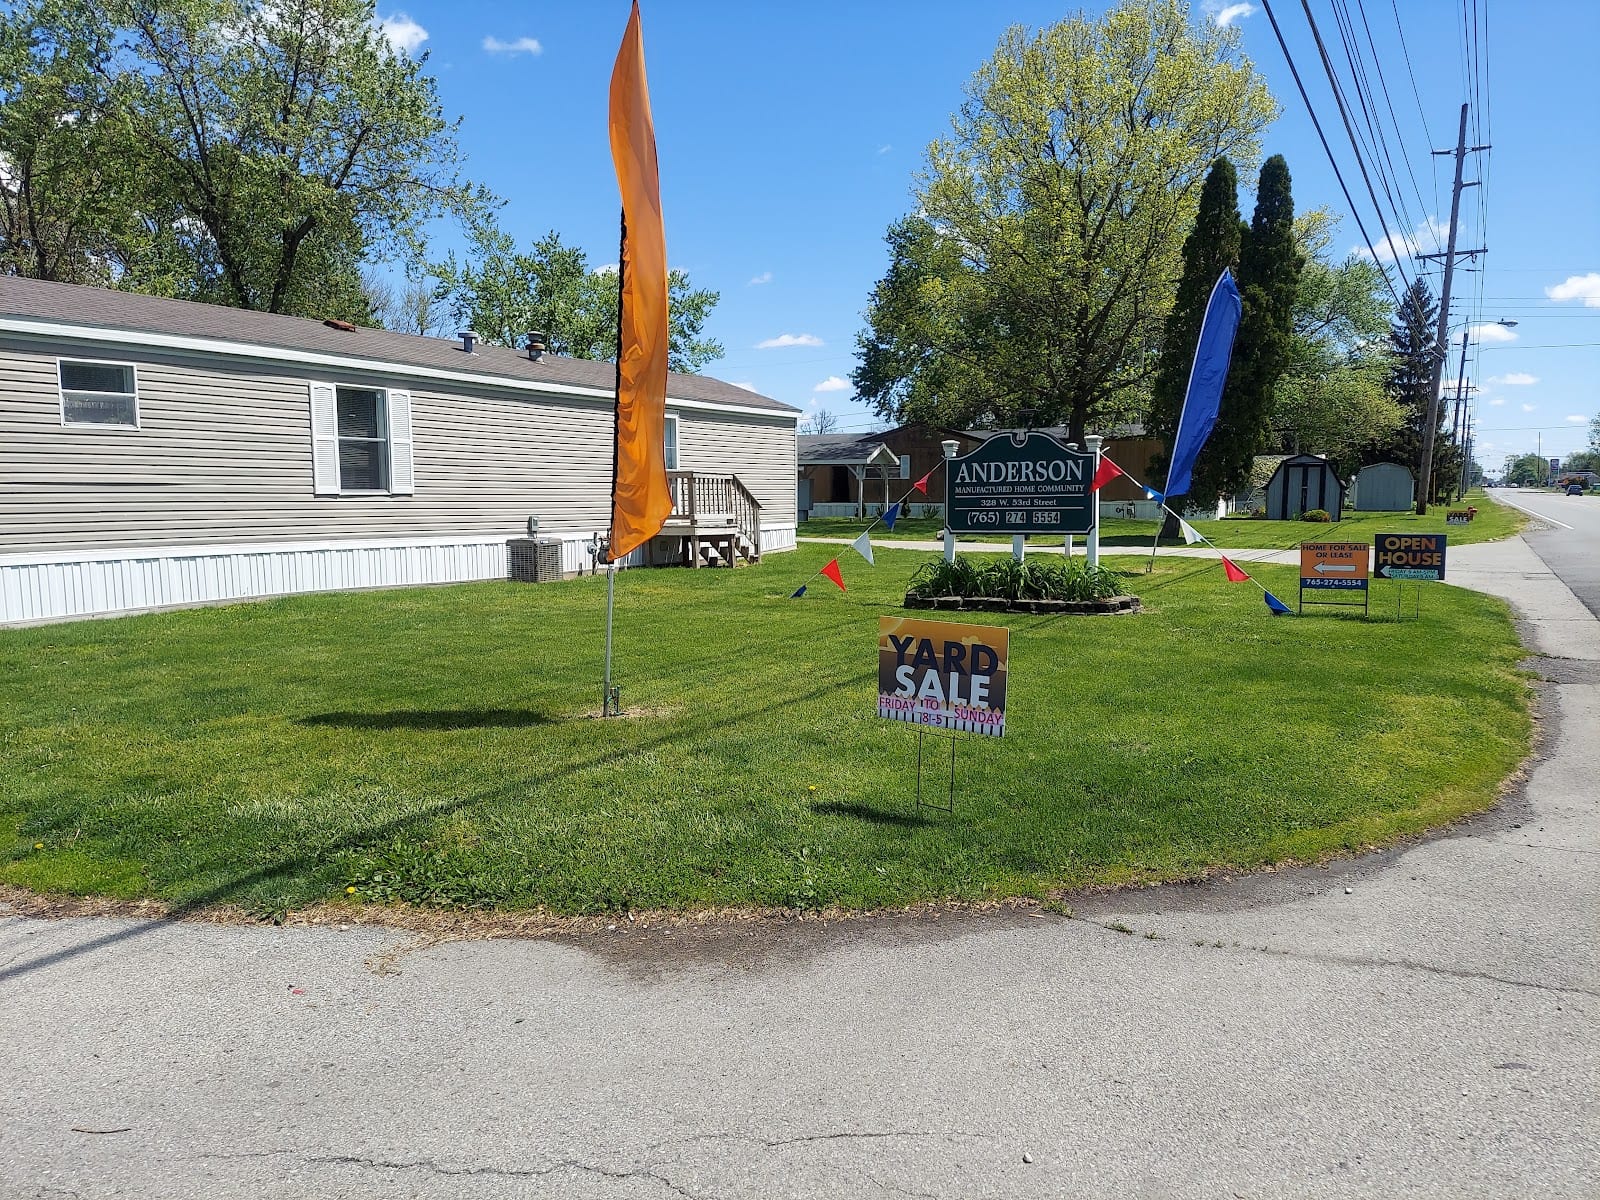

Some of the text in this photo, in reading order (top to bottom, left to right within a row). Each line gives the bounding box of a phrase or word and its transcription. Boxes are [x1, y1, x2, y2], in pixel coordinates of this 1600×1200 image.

[955, 460, 1084, 483] ANDERSON
[955, 484, 1085, 494] MANUFACTURED HOME COMMUNITY
[980, 499, 997, 507] 328
[999, 499, 1010, 507] W.
[1033, 498, 1057, 506] Street
[967, 511, 1060, 525] (765) 274 5554
[1384, 536, 1437, 550] OPEN
[1378, 551, 1442, 566] HOUSE
[888, 634, 999, 677] YARD
[894, 664, 991, 710] SALE
[879, 697, 1003, 725] FRIDAY TO SUNDAY
